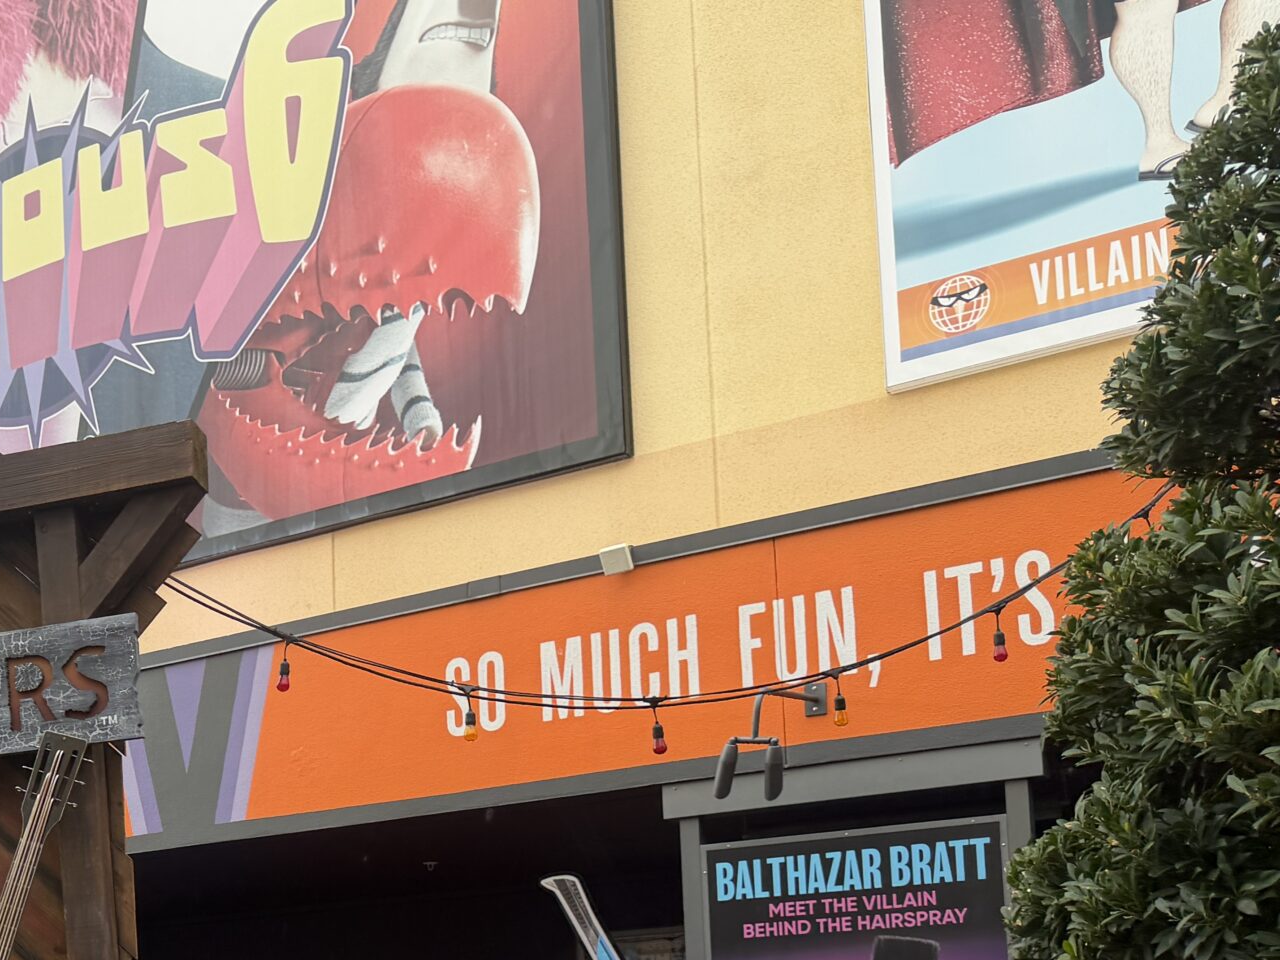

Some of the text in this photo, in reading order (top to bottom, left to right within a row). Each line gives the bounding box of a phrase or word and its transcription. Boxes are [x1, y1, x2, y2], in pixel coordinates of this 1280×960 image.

[445, 549, 1057, 738] SO MUCH FUN, IT'S
[715, 837, 991, 902] BALTHAZAR BRATT
[743, 908, 968, 938] BEHIND THE HAIRSPRAY
[769, 891, 937, 918] MEET THE VILLAIN
